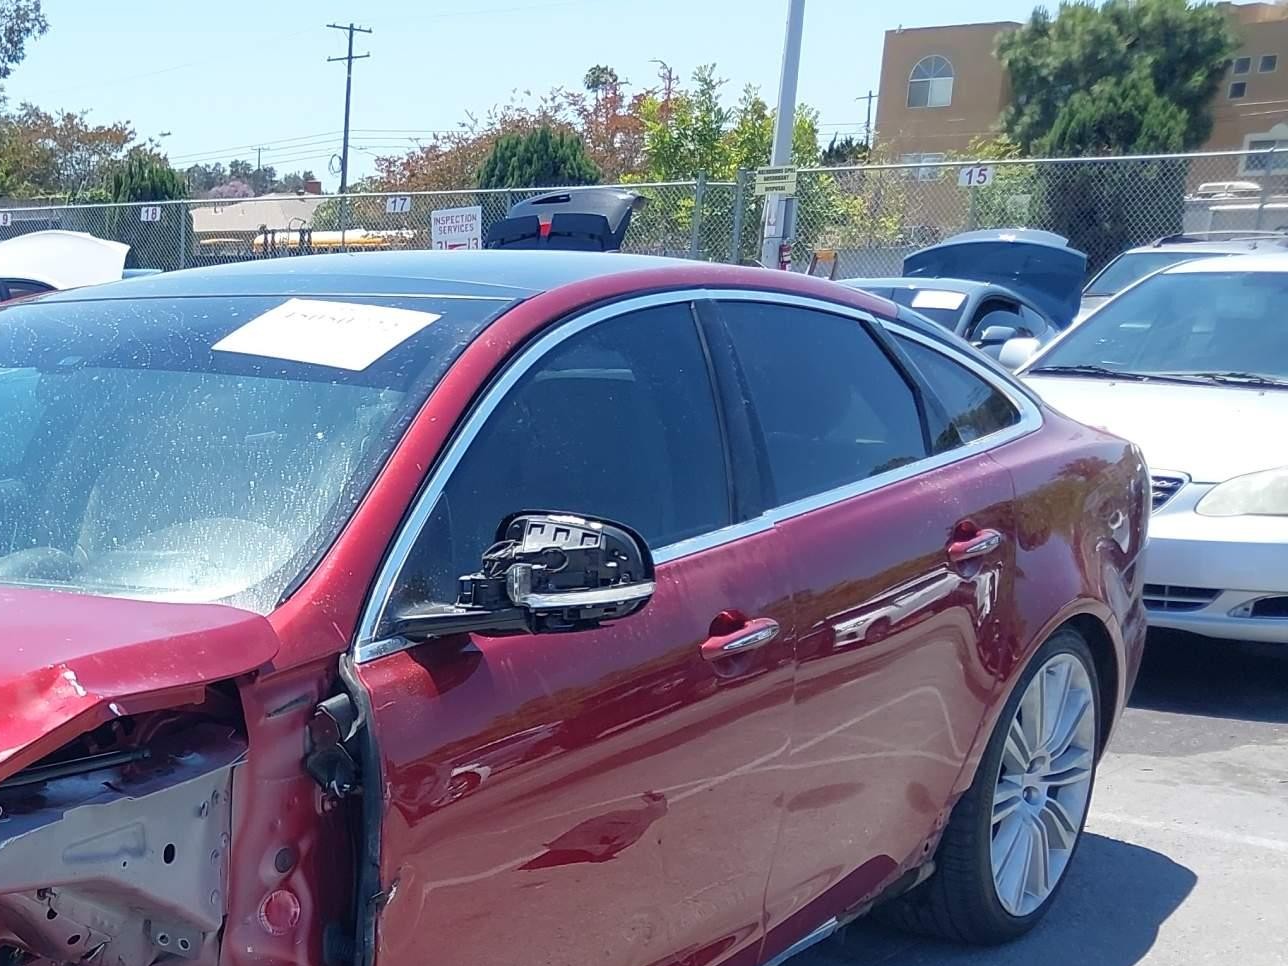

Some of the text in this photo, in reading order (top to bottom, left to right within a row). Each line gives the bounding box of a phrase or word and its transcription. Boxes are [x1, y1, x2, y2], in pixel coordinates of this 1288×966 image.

[966, 168, 987, 185] 15
[391, 197, 408, 211] 17
[145, 207, 158, 220] 18
[433, 214, 477, 226] INSPECTION
[438, 224, 474, 235] SERVICES
